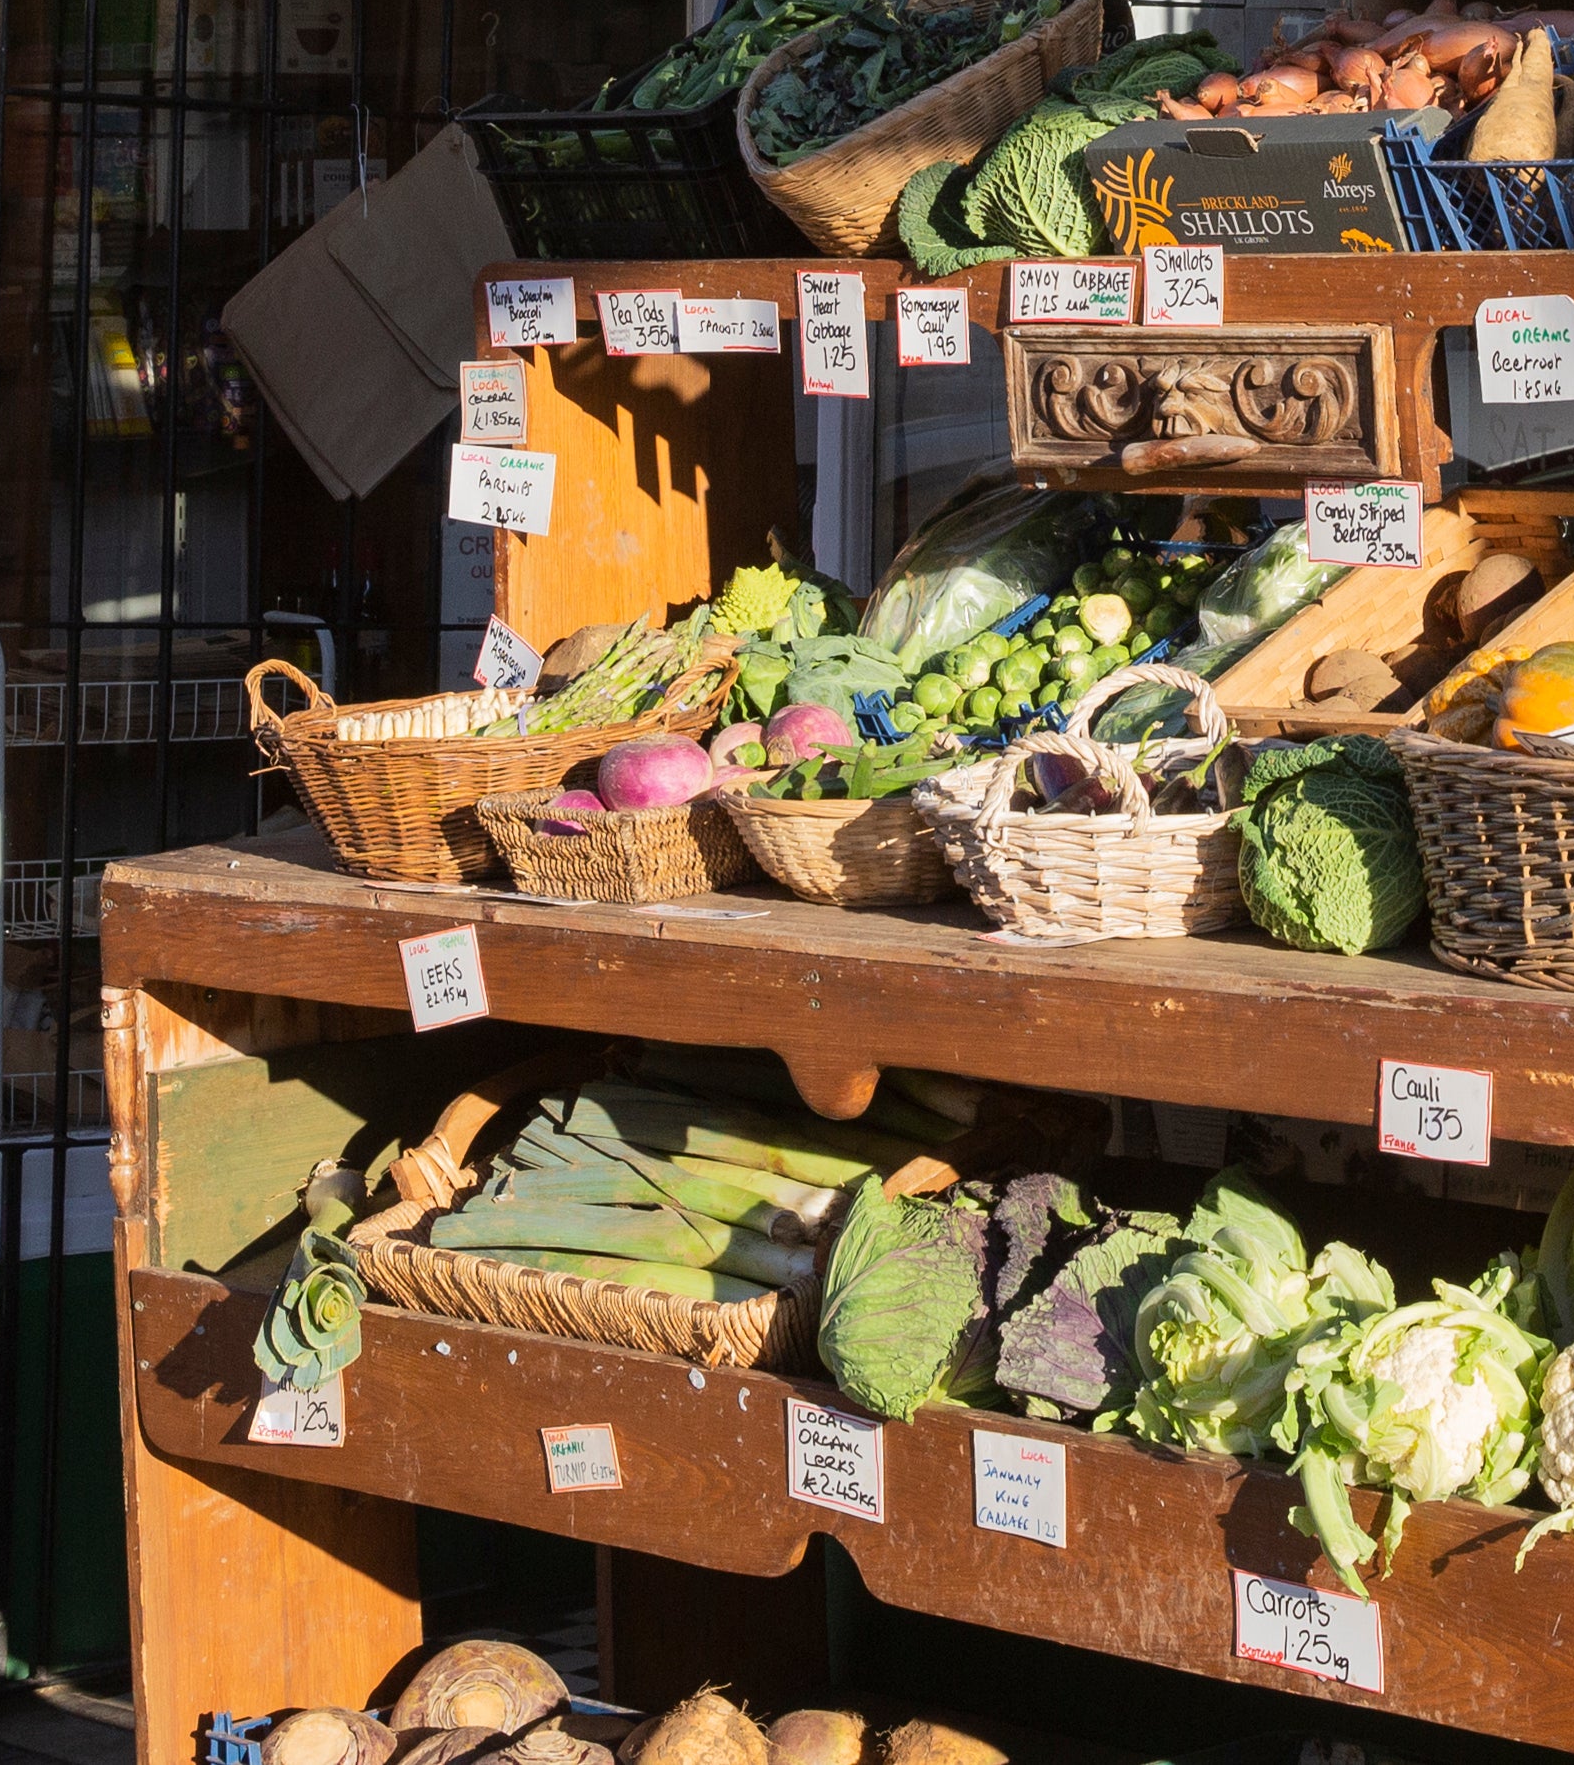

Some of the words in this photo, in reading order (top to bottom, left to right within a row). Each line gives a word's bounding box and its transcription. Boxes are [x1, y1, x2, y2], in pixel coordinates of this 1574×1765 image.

[1323, 181, 1375, 203] Abreys
[1201, 196, 1280, 210] BRECKLAND
[1180, 210, 1314, 236] SHALLOTS
[1154, 249, 1213, 273] Shallots
[802, 274, 841, 294] Sweet
[1019, 269, 1060, 290] SAVOY
[1073, 270, 1131, 293] CABBAGE
[609, 293, 633, 326] Pea
[633, 293, 665, 323] Pods
[685, 304, 716, 315] LOCAL
[813, 295, 841, 316] Heart
[900, 291, 960, 323] Romanesque
[1065, 298, 1090, 311] each
[1099, 306, 1126, 317] LOCAL
[1151, 306, 1173, 320] UK
[917, 313, 945, 334] Cauli
[1485, 308, 1532, 323] LOCAL
[493, 330, 508, 343] UK
[806, 319, 852, 347] Cabbage
[1492, 351, 1562, 373] Beetroot
[469, 369, 516, 380] ORGANIC
[472, 380, 508, 391] LOCAL
[461, 451, 492, 464] LOCAL
[500, 456, 544, 470] ORGANIC
[1354, 483, 1409, 505] Organic
[1316, 501, 1355, 527] Candy
[1359, 503, 1405, 530] Striped
[1333, 522, 1382, 543] Beetroot
[490, 621, 513, 649] White
[409, 943, 430, 956] LOCAL
[421, 957, 463, 989] LEEKS
[1391, 1067, 1440, 1102] Cauli
[1384, 1134, 1417, 1151] France
[798, 1408, 850, 1433] LOCAL
[551, 1441, 585, 1457] ORGANIC
[799, 1429, 863, 1459] ORGANIC
[1021, 1447, 1052, 1464] LOCAL
[554, 1461, 586, 1484] TURNIP
[983, 1459, 1041, 1490] JANUARY
[996, 1490, 1030, 1507] KING
[1246, 1579, 1331, 1627] Carrots
